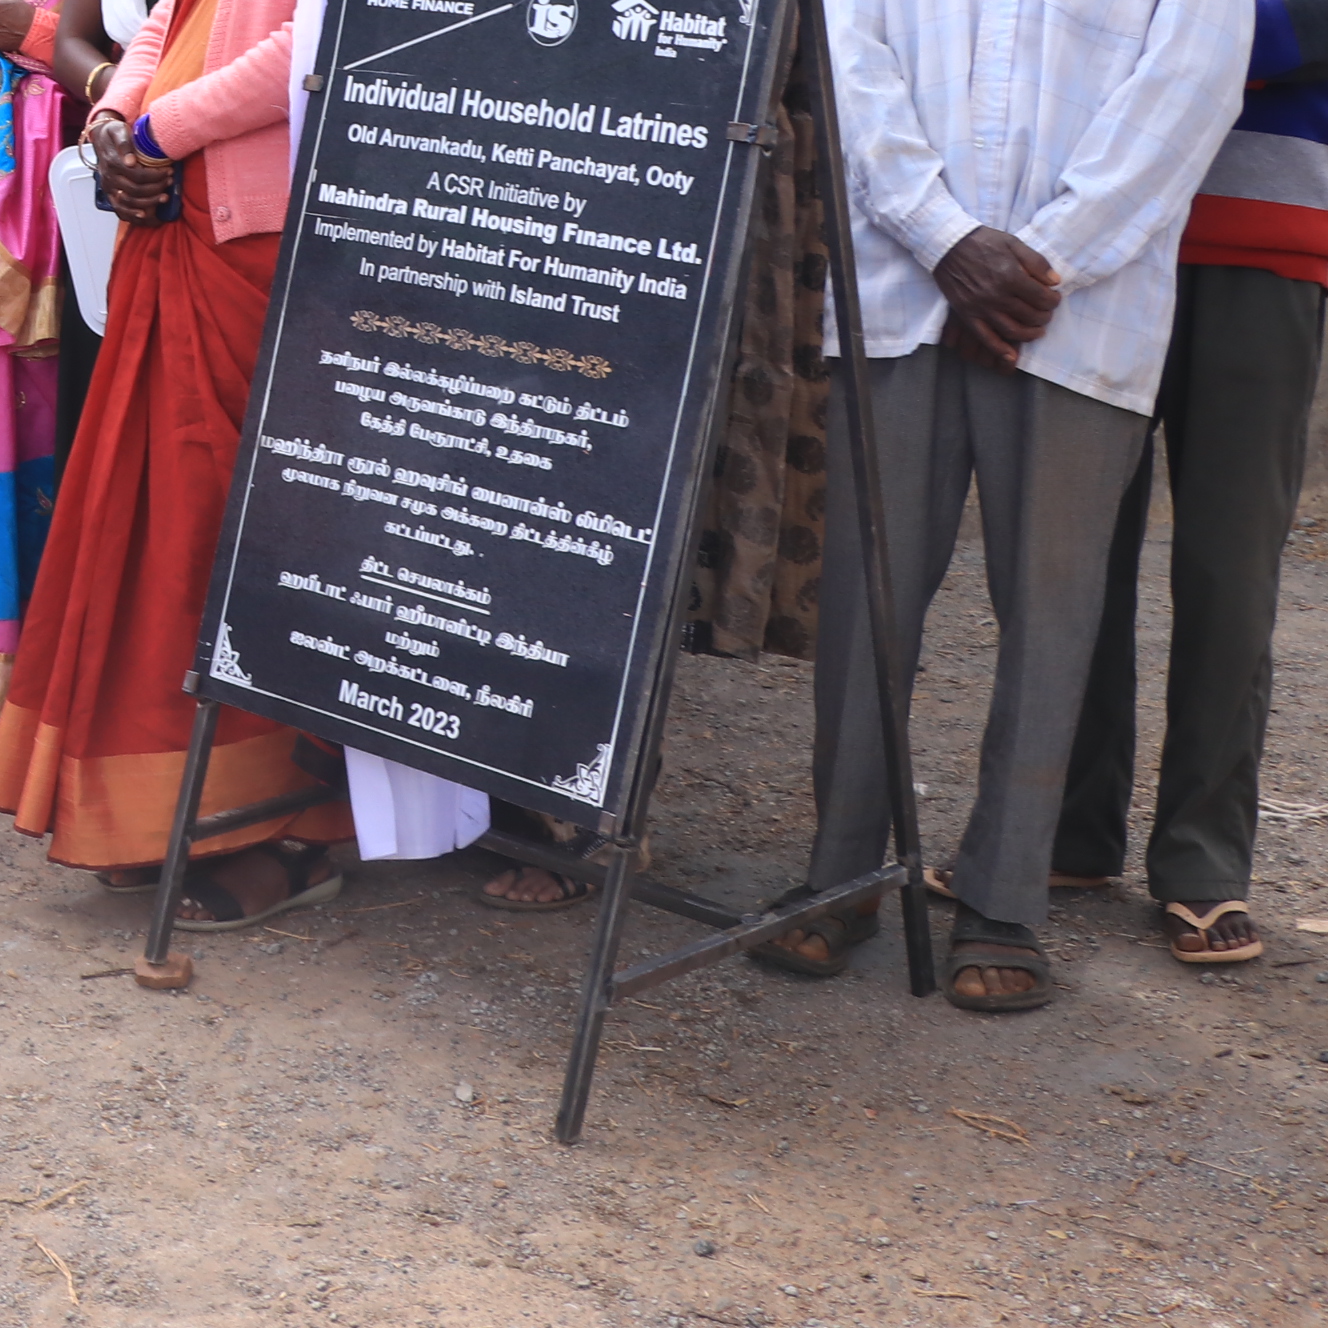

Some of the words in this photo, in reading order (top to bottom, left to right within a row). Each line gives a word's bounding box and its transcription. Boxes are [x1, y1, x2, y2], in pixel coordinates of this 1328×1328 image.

[657, 33, 674, 45] for
[659, 10, 727, 37] Habitat
[654, 46, 678, 59] India
[344, 75, 458, 115] Individual
[461, 87, 597, 134] Household
[600, 106, 709, 149] Latrines
[347, 123, 377, 145] Old
[379, 127, 486, 164] Aruvankadu,
[491, 143, 535, 168] Ketti
[537, 149, 641, 186] Panchayat,
[646, 165, 695, 196] Ooty
[426, 171, 441, 191] A
[444, 173, 484, 198] CSR
[487, 179, 560, 210] Initiative
[562, 191, 588, 218] by
[317, 183, 408, 215] Mahindra
[412, 198, 468, 225] Rural
[471, 207, 558, 244] Housing
[562, 222, 652, 256] Finance
[656, 237, 702, 265] Ltd.
[314, 217, 415, 251] Implemented
[417, 233, 439, 259] by
[440, 237, 506, 267] Habitat
[508, 249, 542, 273] For
[543, 255, 635, 294] Humanity
[638, 272, 688, 300] India
[359, 257, 375, 277] In
[377, 263, 469, 298] partnership
[472, 279, 506, 301] with
[509, 283, 567, 313] Island
[571, 295, 621, 323] Trust
[334, 380, 387, 403] பழைய
[518, 391, 573, 415] கட்டும்
[573, 401, 630, 428] திட்டம்
[495, 445, 553, 471] உதகை
[385, 631, 441, 658] மற்றும்
[495, 631, 571, 668] இந்தியா
[338, 679, 405, 721] March
[407, 702, 461, 740] 2023
